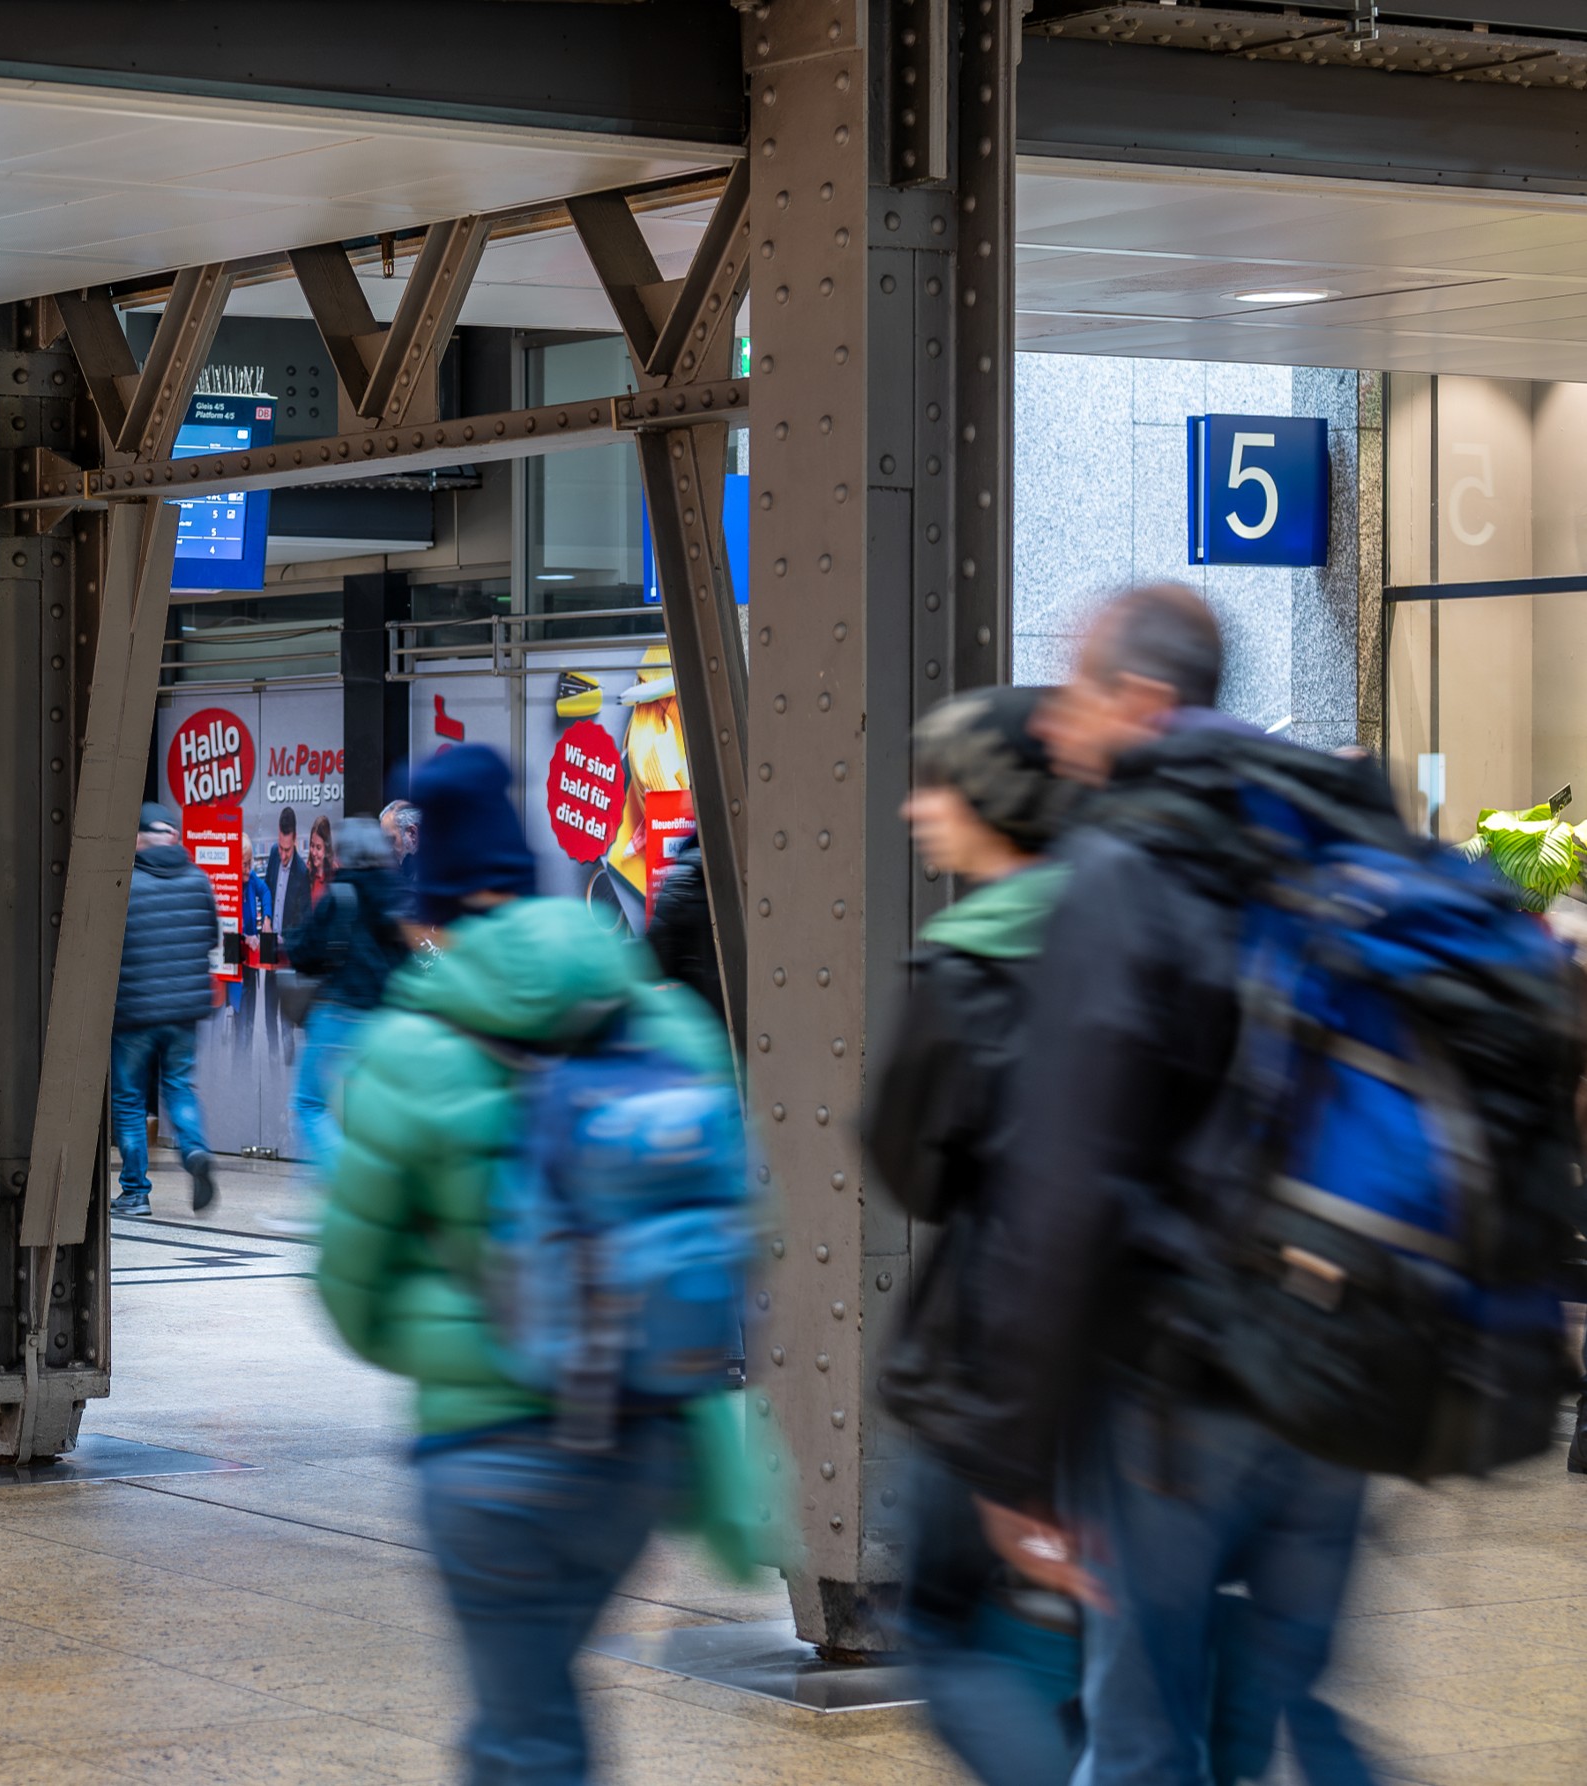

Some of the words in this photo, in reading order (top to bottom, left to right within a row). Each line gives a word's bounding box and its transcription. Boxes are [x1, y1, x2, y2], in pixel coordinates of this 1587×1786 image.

[195, 411, 224, 419] Platform
[224, 412, 235, 420] 4/5
[196, 402, 213, 410] Gleis
[214, 403, 224, 411] 4/5
[257, 408, 270, 418] DB
[1225, 432, 1278, 540] 5
[180, 720, 241, 767] Hallo
[267, 743, 345, 782] McPape
[183, 756, 243, 806] Köln!
[564, 743, 586, 768] Wir
[587, 757, 616, 783] sind
[267, 779, 322, 806] Coming
[323, 783, 345, 801] so
[560, 772, 588, 802] bald
[590, 785, 611, 811] für
[556, 803, 584, 830] dich
[585, 818, 607, 841] da!
[651, 818, 696, 830] Neueröffnu
